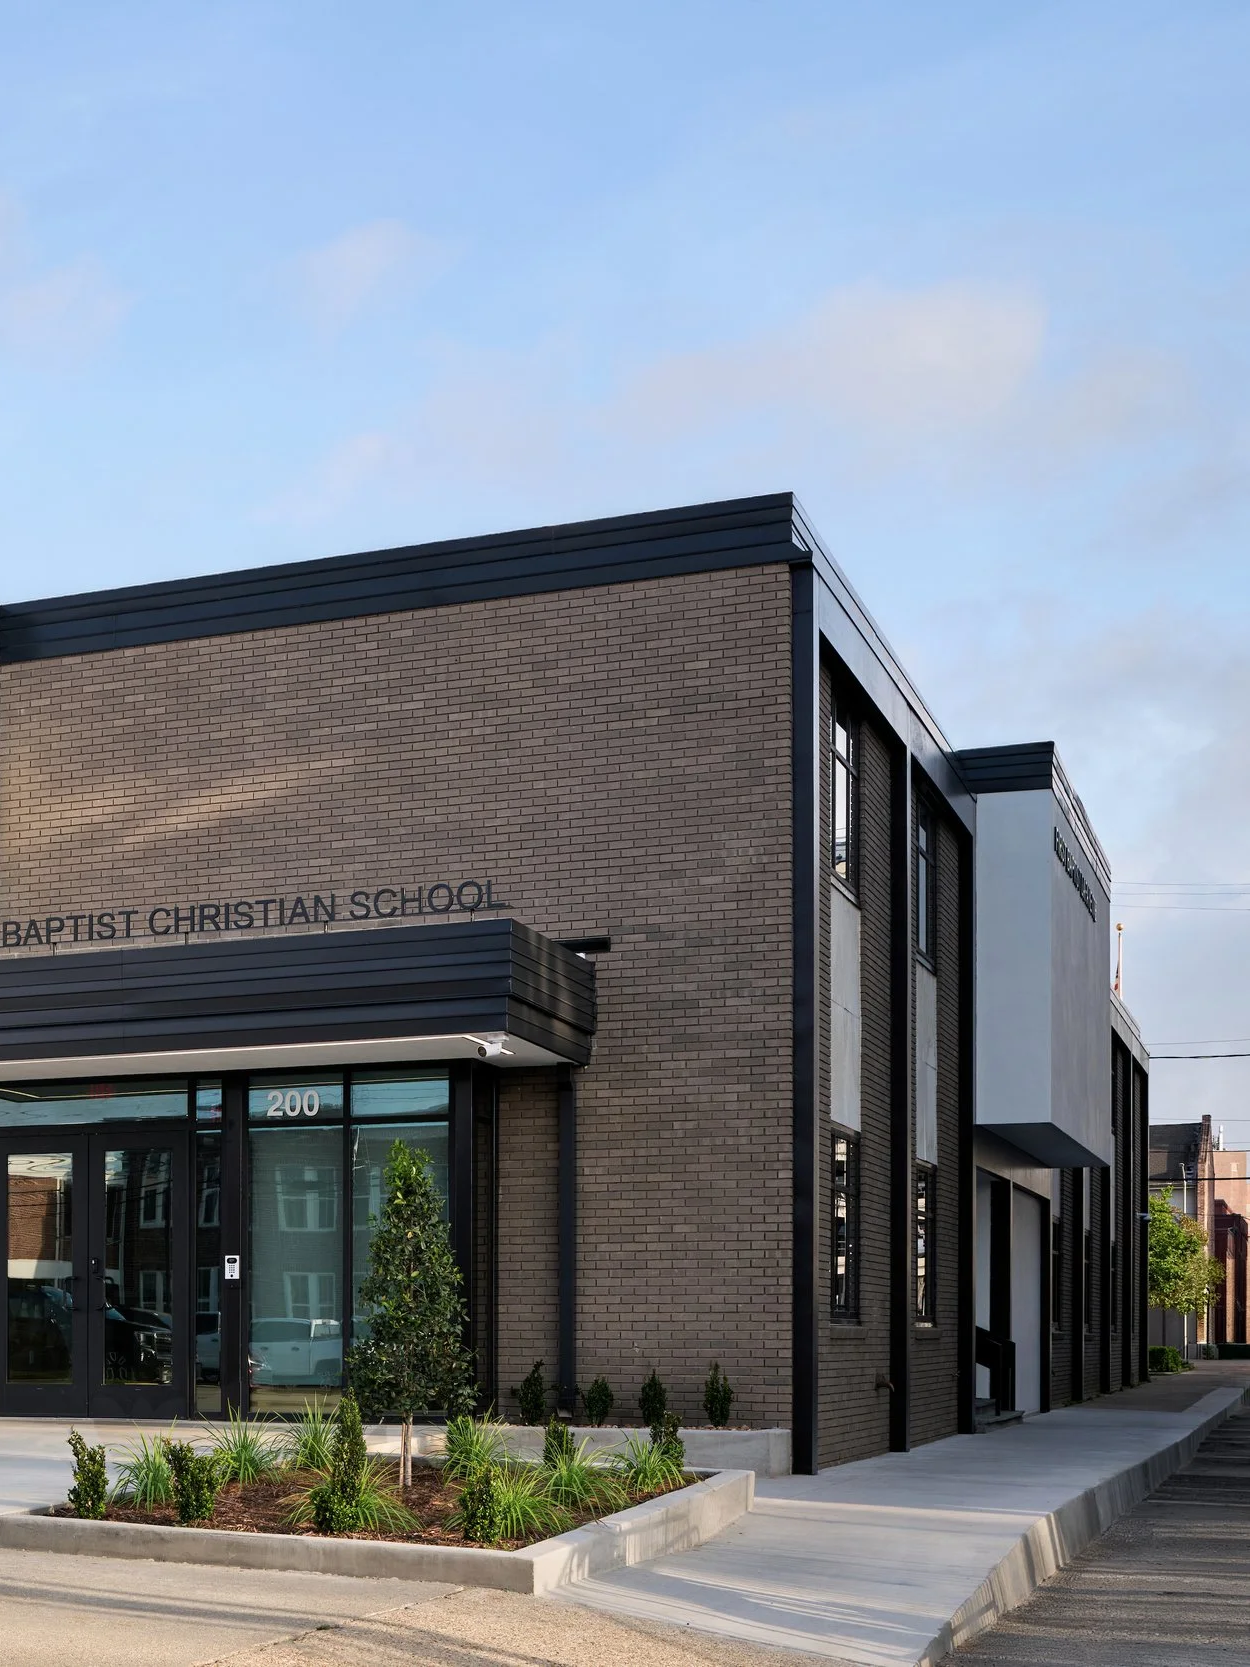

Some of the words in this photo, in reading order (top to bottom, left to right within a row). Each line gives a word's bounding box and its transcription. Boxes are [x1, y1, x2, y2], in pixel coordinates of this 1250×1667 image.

[2, 909, 138, 947] BAPTIST
[149, 893, 336, 935] CHRISTIAN
[350, 879, 506, 920] SCHOOL
[266, 1090, 320, 1117] 200
